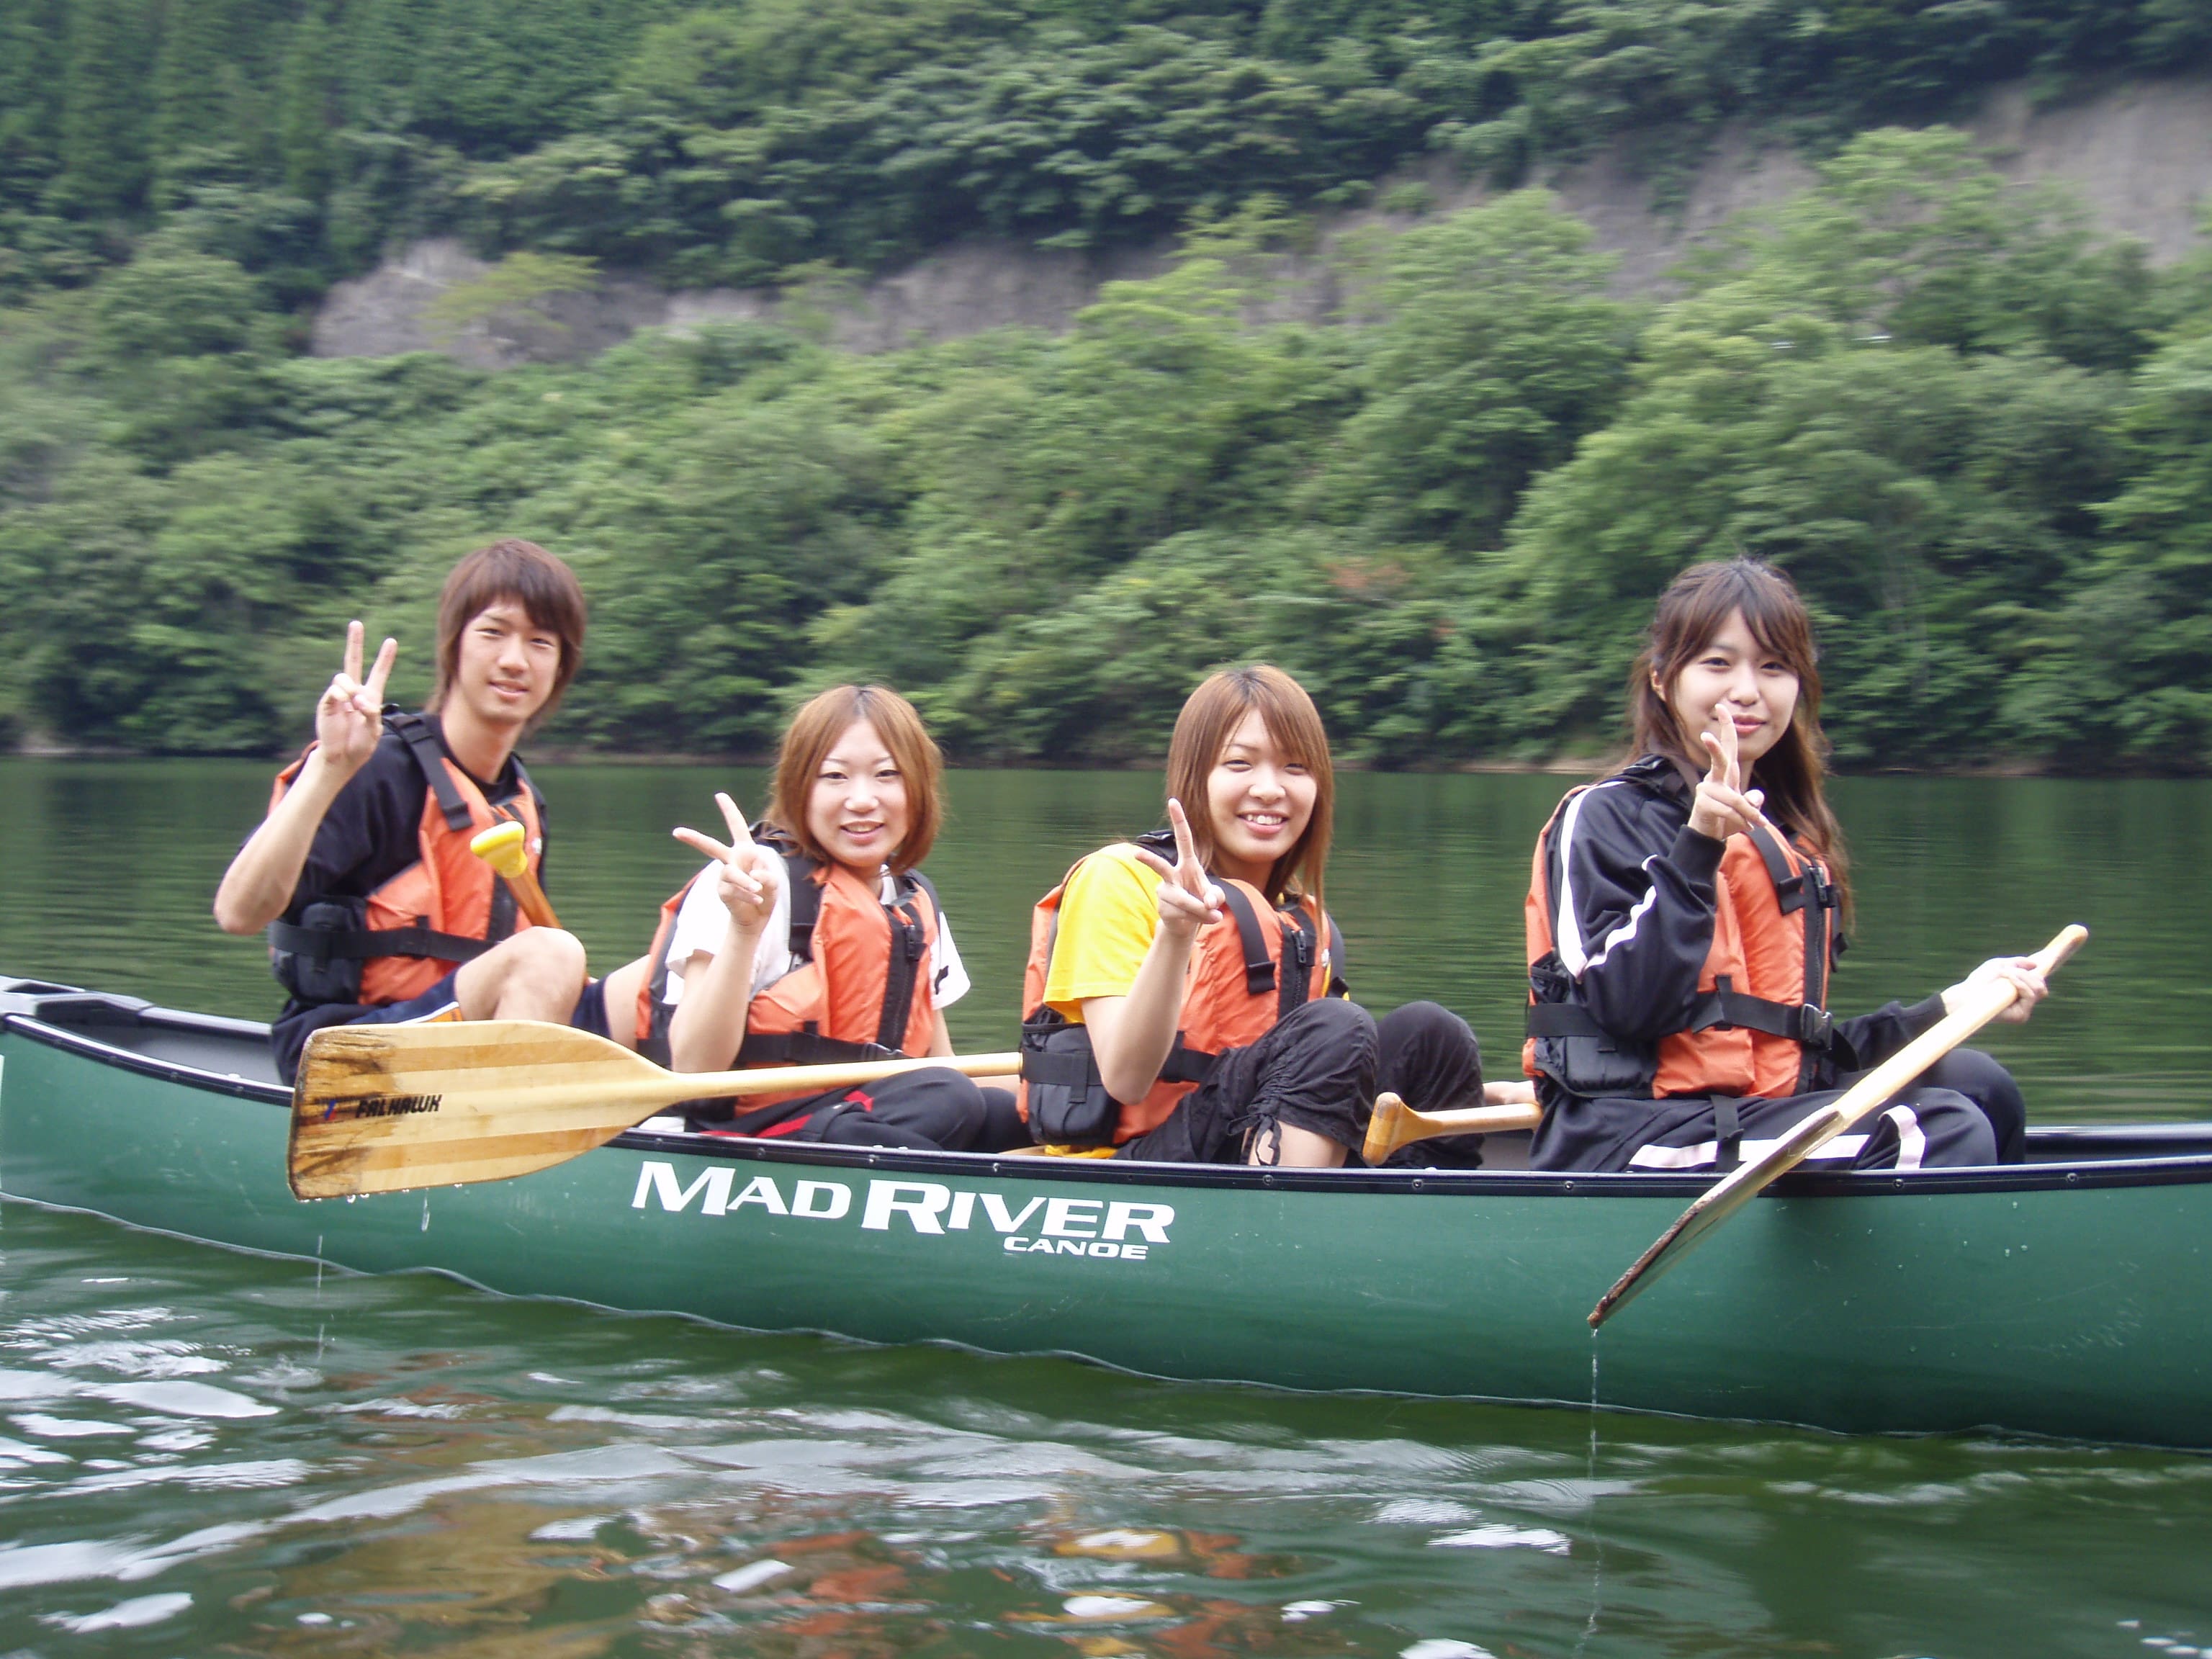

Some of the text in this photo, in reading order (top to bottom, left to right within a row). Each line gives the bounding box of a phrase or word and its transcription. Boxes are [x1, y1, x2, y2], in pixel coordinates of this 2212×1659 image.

[631, 1161, 1175, 1244] MAD RIVER
[1003, 1236, 1150, 1260] CANOE
